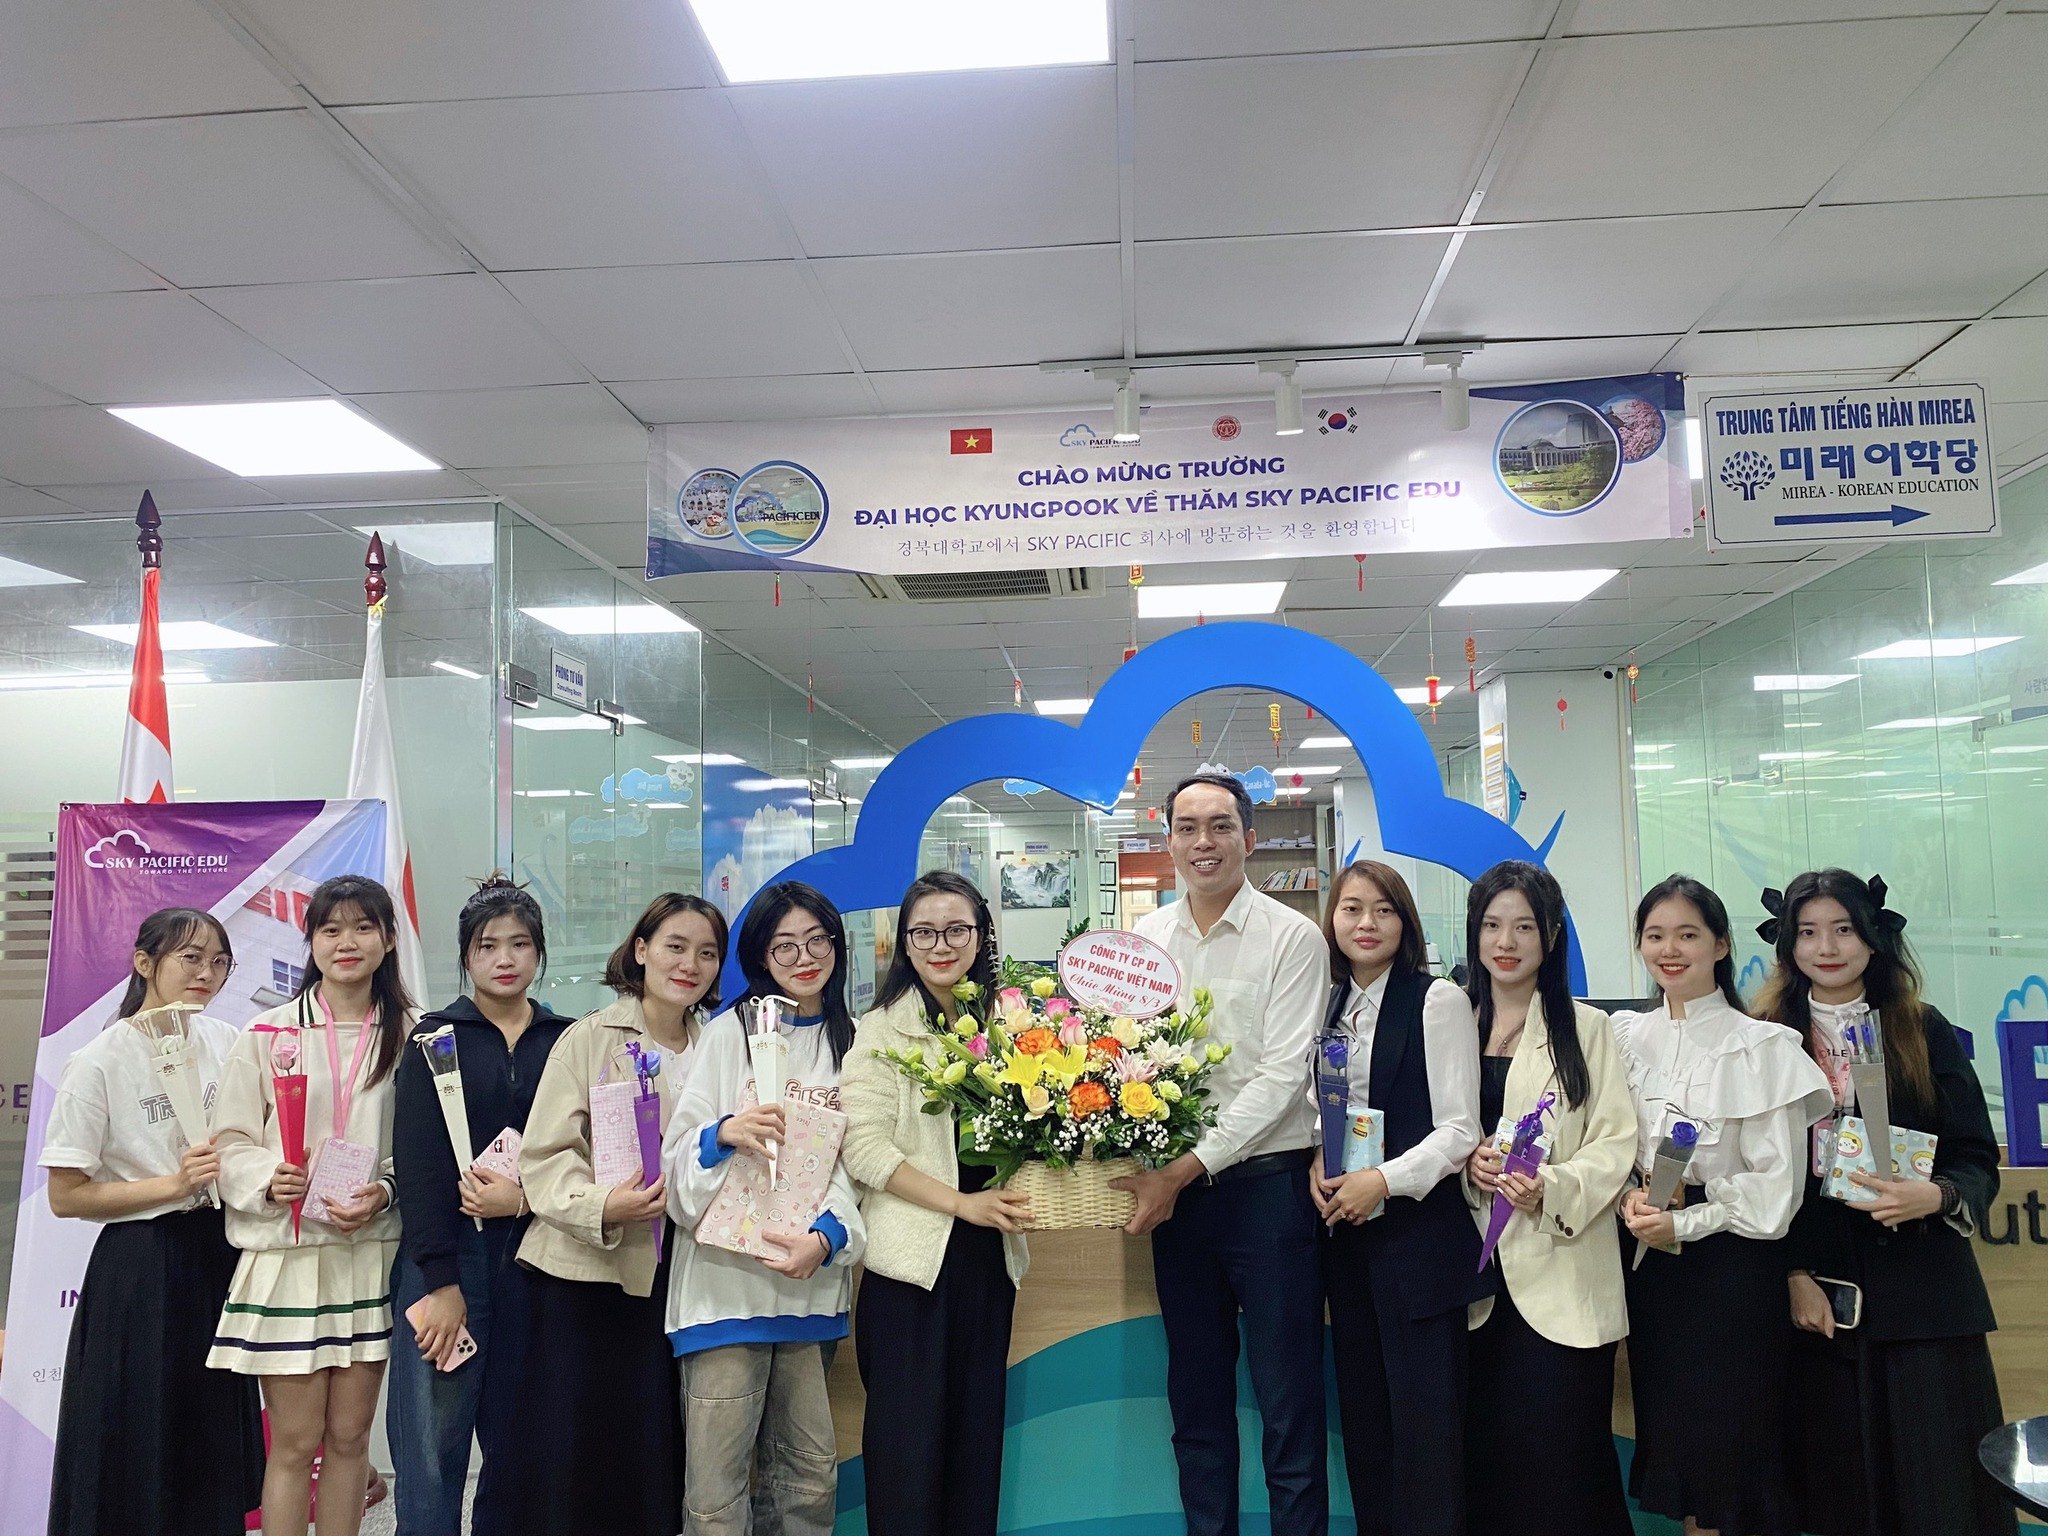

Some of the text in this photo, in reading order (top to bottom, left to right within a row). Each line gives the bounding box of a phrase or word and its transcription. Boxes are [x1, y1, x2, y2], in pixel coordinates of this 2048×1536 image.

[1716, 396, 1976, 436] TRUNG TÂM TIẾNG HÀN MIREA
[1018, 455, 1285, 486] CHÀO MỪNG TRƯỜNG
[854, 481, 1461, 529] ĐẠI HỌC KYUNGPOOK VỀ THĂM SKY PACIFIC EDU
[1782, 485, 1827, 500] MIREA
[1838, 481, 1894, 497] KOREAN
[1898, 478, 1980, 495] EDUCATION
[897, 536, 1019, 557] 경북대학교에서
[1027, 536, 1060, 551] SKY
[1066, 532, 1131, 549] PACIFIC
[1139, 528, 1191, 547] 회사에
[1200, 525, 1272, 544] 방문하는
[1281, 522, 1316, 540] 것을
[105, 855, 228, 868] SKY PACIFIC EDU
[1090, 944, 1117, 960] CÔNG
[1119, 952, 1130, 964] TY
[1131, 956, 1144, 968] CP
[1067, 956, 1173, 995] SKY PACIFIC VIỆT NAM
[1069, 973, 1161, 1008] Chúc Mừng 8/3
